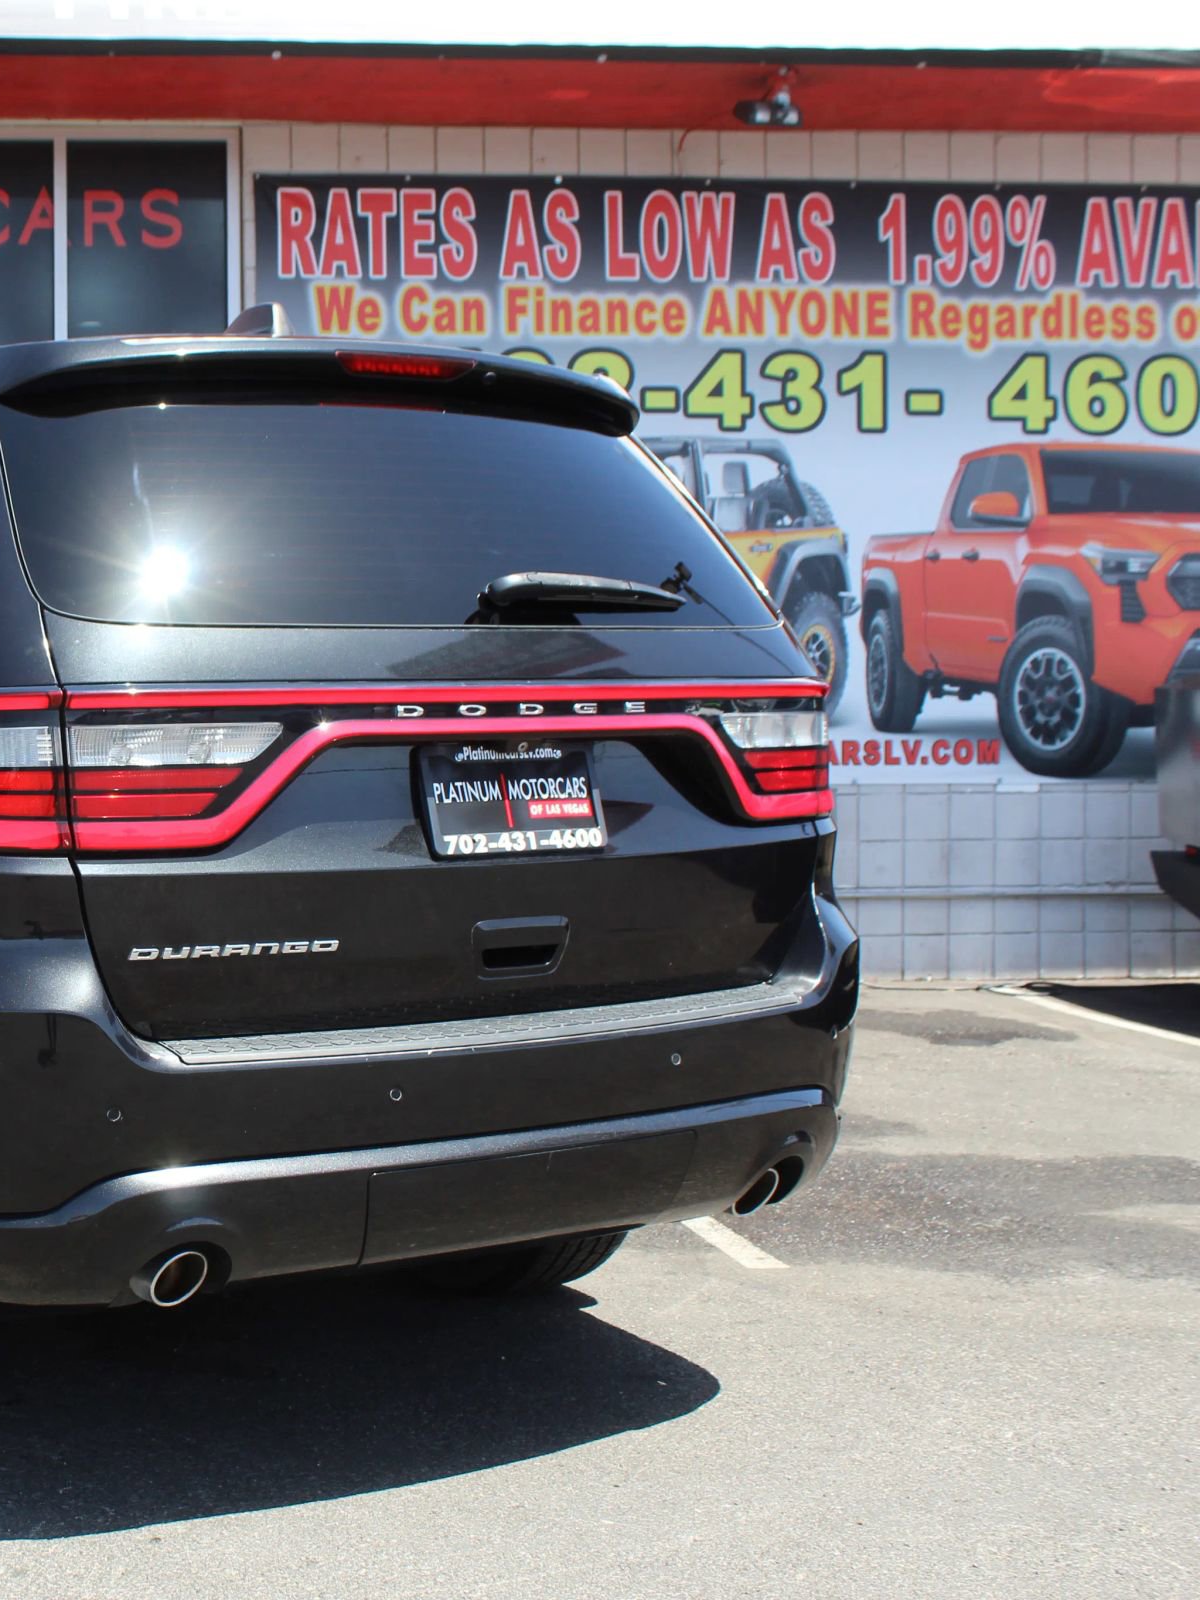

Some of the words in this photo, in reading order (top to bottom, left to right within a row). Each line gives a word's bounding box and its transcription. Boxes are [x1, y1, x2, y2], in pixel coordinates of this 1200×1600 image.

[276, 187, 480, 281] RATES
[499, 188, 584, 281] AS
[604, 190, 737, 283] LOW
[757, 193, 838, 285] AS
[878, 194, 1057, 290] 1.99%
[1075, 197, 1200, 290] AVA
[313, 284, 383, 334] We
[399, 284, 486, 335] Can
[504, 285, 687, 336] Finance
[704, 287, 891, 338] ANYONE
[910, 291, 1157, 353] Regardless
[395, 701, 645, 717] DODGE
[433, 780, 502, 804] PLATINUM
[508, 776, 588, 801] MOTORCARS
[530, 805, 543, 816] OF
[546, 804, 562, 815] LAS
[563, 803, 590, 814] VEGAS
[443, 827, 602, 855] 702-431-4600
[127, 939, 340, 961] DURANGO
